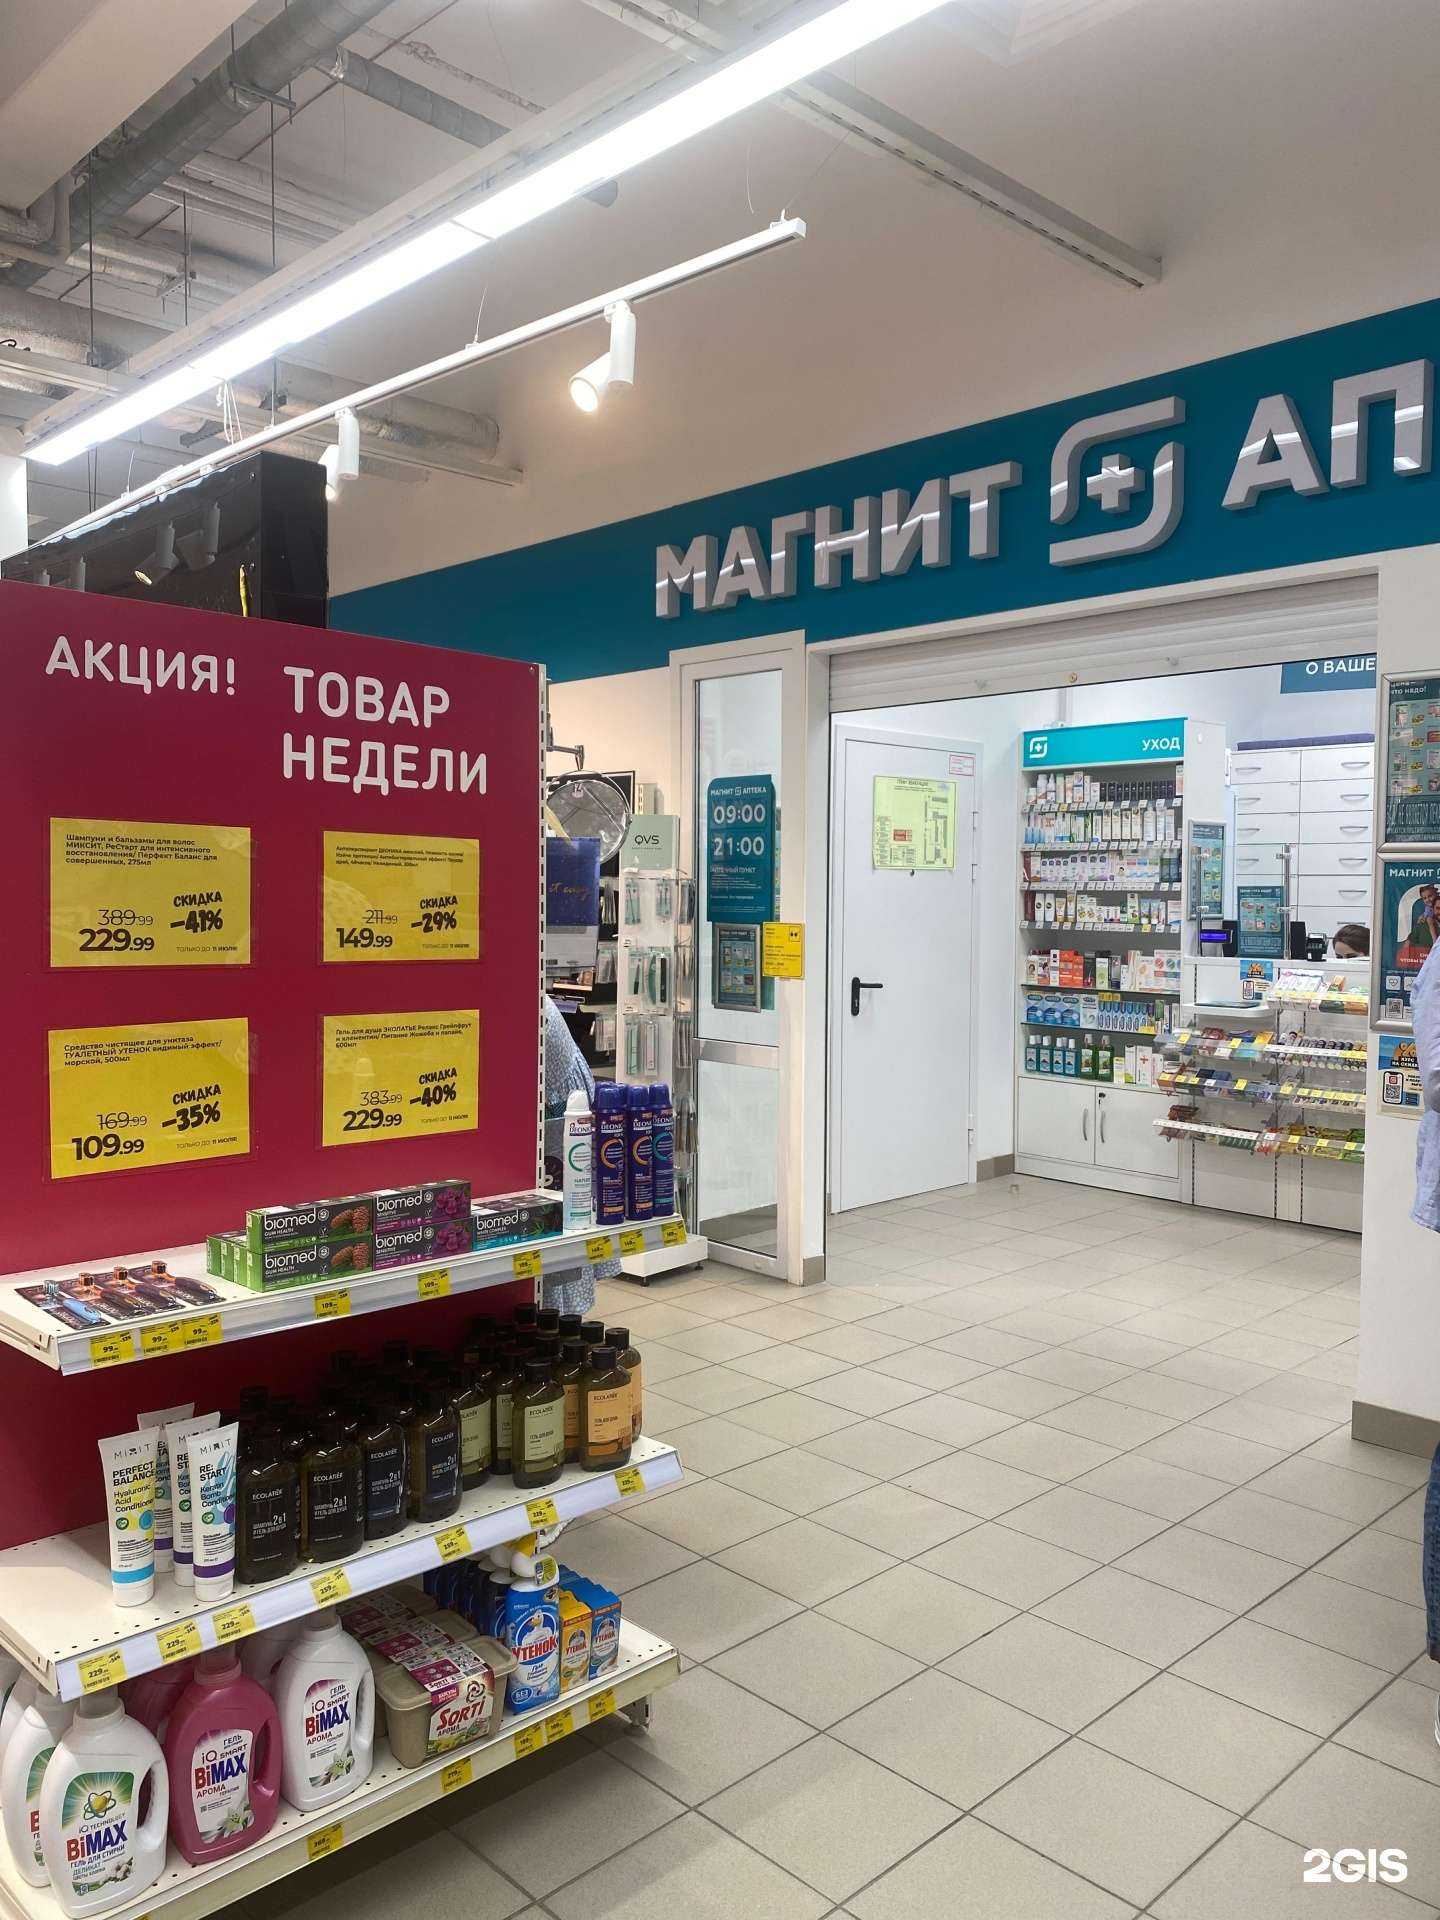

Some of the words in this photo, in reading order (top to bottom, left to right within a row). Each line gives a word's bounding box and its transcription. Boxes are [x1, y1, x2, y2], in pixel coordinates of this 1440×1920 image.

[655, 460, 1022, 619] МАГНИТ
[45, 634, 237, 696] АКЦИЯ!
[1306, 661, 1318, 675] О
[283, 665, 450, 728] ТОВАР
[1143, 736, 1181, 752] УХОД
[282, 732, 487, 796] НЕДЕЛИ
[714, 804, 766, 824] 09:00
[66, 834, 106, 843] Шампуни
[115, 836, 155, 845] бальзамы
[156, 838, 171, 846] для
[105, 843, 139, 852] РеСтарт
[156, 846, 211, 854] интенсивного
[634, 835, 660, 845] QVS
[714, 836, 765, 856] 21:00
[65, 850, 137, 859] восстановления/
[138, 851, 172, 860] Перфект
[174, 853, 202, 861] Баланс
[65, 858, 126, 866] совершенных,
[1389, 868, 1434, 877] МАГНИТ
[173, 891, 223, 908] СКИДКА
[420, 895, 459, 910] СКИДКА
[98, 909, 154, 926] 389.99
[79, 928, 155, 952] 229.99
[336, 927, 393, 949] 149.99
[64, 1042, 104, 1051] Средство
[105, 1039, 145, 1048] чистящее
[146, 1038, 162, 1046] для
[163, 1036, 194, 1044] унитаза
[64, 1049, 116, 1059] ТУАЛЕТНЫЙ
[118, 1047, 151, 1055] УТЕНОК
[152, 1043, 189, 1052] видимый
[191, 1039, 223, 1049] эффект/
[64, 1057, 103, 1067] морской,
[104, 1056, 130, 1064] 500мл
[419, 1067, 458, 1085] СКИДКА
[172, 1084, 222, 1106] СКИДКА
[360, 1089, 403, 1107] 383.99
[97, 1111, 148, 1130] 169.99
[343, 1108, 403, 1132] 229.99
[72, 1133, 145, 1161] 109.99
[176, 1140, 201, 1150] ТОЛЬКО
[200, 1139, 211, 1148] ДО
[376, 1190, 423, 1213] biomed
[264, 1207, 317, 1231] biomed
[476, 1209, 519, 1231] biomed
[276, 1228, 294, 1236] HEALTH
[375, 1226, 423, 1249] biomed
[265, 1244, 317, 1269] biomed
[277, 1266, 295, 1274] HEALTH
[112, 1461, 154, 1479] PERFECT
[200, 1464, 214, 1473] RE:
[200, 1467, 227, 1482] START
[113, 1469, 156, 1487] BALANCE
[113, 1484, 152, 1499] Hyaluronic
[200, 1481, 224, 1494] Keratin
[201, 1490, 222, 1501] Bomb
[115, 1497, 132, 1506] Acid
[333, 1495, 347, 1508] 2в1
[273, 1512, 286, 1526] 2в1
[595, 1631, 616, 1643] УТЕНОК
[512, 1635, 557, 1661] УТЕНОК
[566, 1642, 587, 1656] УТЕНОК
[330, 1683, 346, 1695] ГЕЛЬ
[311, 1699, 325, 1714] iQ
[327, 1692, 351, 1708] SMART
[305, 1701, 350, 1738] BiMAX
[223, 1734, 242, 1746] ГЕЛЬ
[307, 1731, 333, 1746] АРОМА
[202, 1750, 218, 1764] iQ
[220, 1743, 248, 1759] SMART
[194, 1752, 247, 1790] BiMAX
[196, 1784, 226, 1799] АРОМА
[90, 1812, 126, 1830] TECHNOLOGY
[66, 1819, 128, 1862] BiMAX
[70, 1859, 86, 1869] ГЕЛЬ
[88, 1853, 101, 1864] ДЛЯ
[102, 1844, 125, 1858] СТИРКИ
[73, 1861, 101, 1876] ДЕЛИКАТ
